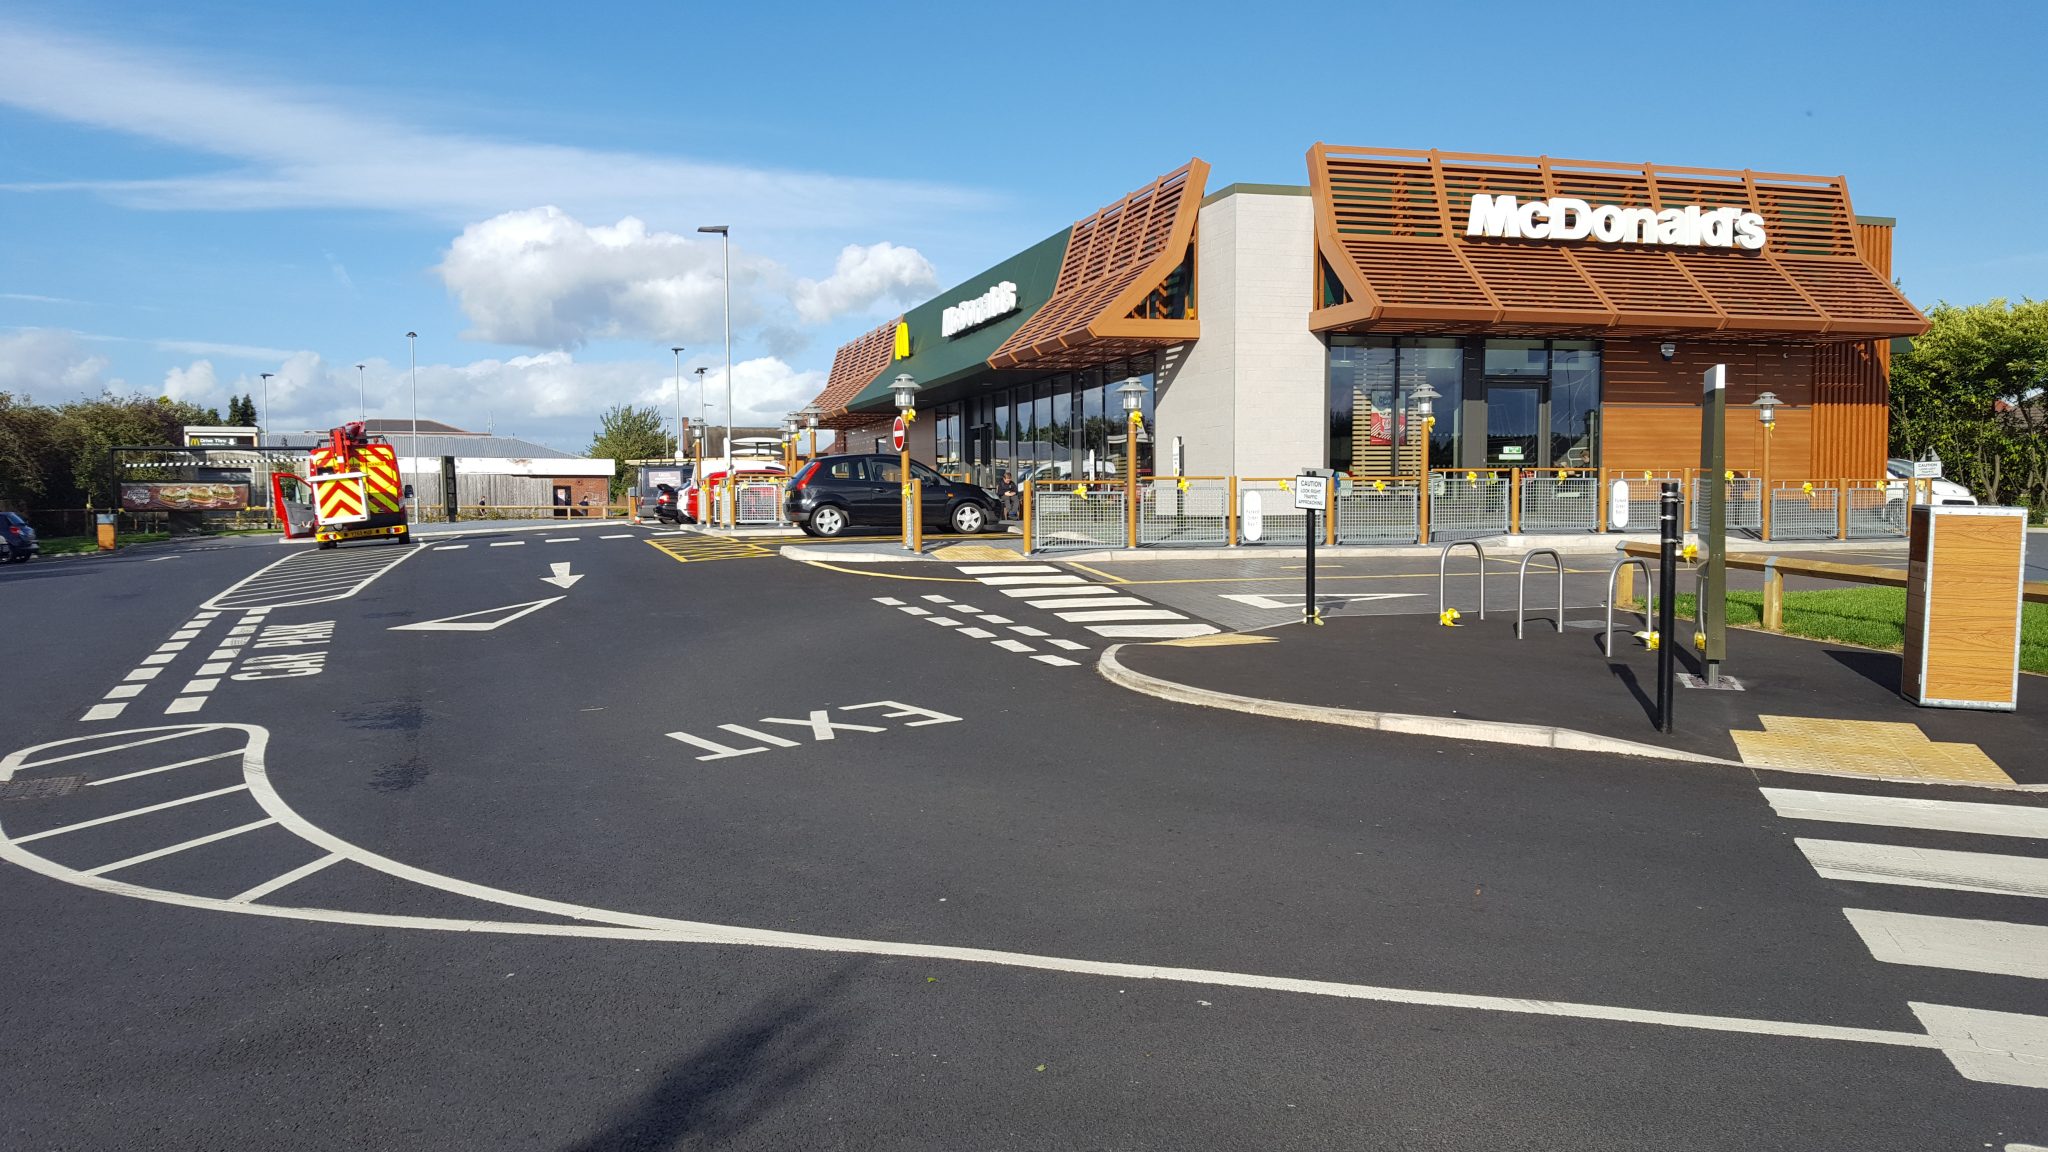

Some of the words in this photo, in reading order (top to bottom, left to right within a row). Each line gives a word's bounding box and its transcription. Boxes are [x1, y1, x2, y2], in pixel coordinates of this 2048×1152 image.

[1466, 193, 1767, 249] McDonald's
[942, 281, 1017, 337] McDonald's
[252, 620, 337, 648] PARK
[230, 652, 328, 681] CAR
[664, 700, 964, 761] EXIT
